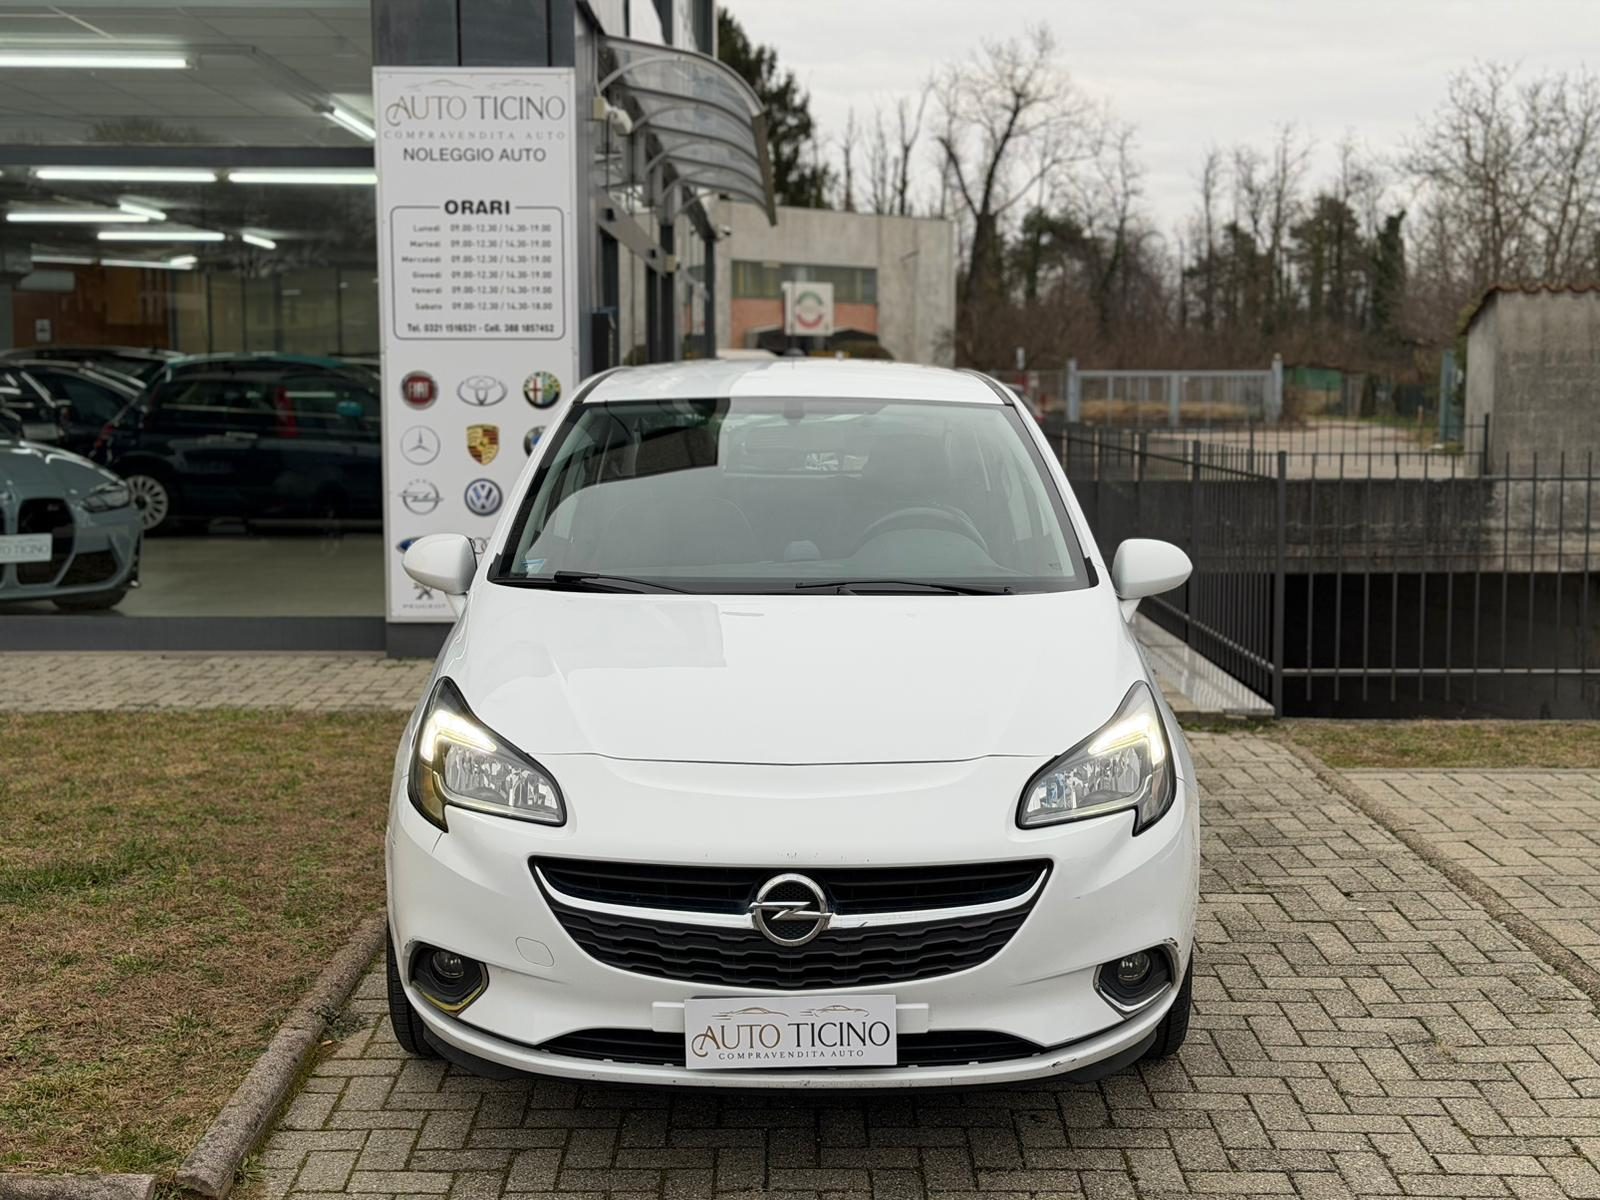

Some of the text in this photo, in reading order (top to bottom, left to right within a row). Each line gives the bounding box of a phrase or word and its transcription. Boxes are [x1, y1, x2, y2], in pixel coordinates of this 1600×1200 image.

[385, 95, 566, 127] AUTO TICINO
[383, 129, 567, 141] COMPRAVENDITA AUTO
[402, 146, 547, 163] NOLEGGIO AUTO
[443, 199, 512, 216] ORARI
[407, 323, 421, 333] Tel.
[484, 323, 501, 333] Cell.
[691, 1020, 891, 1058] AUTO TICINO
[718, 1049, 865, 1060] COMPRAVENDITA AUTO
